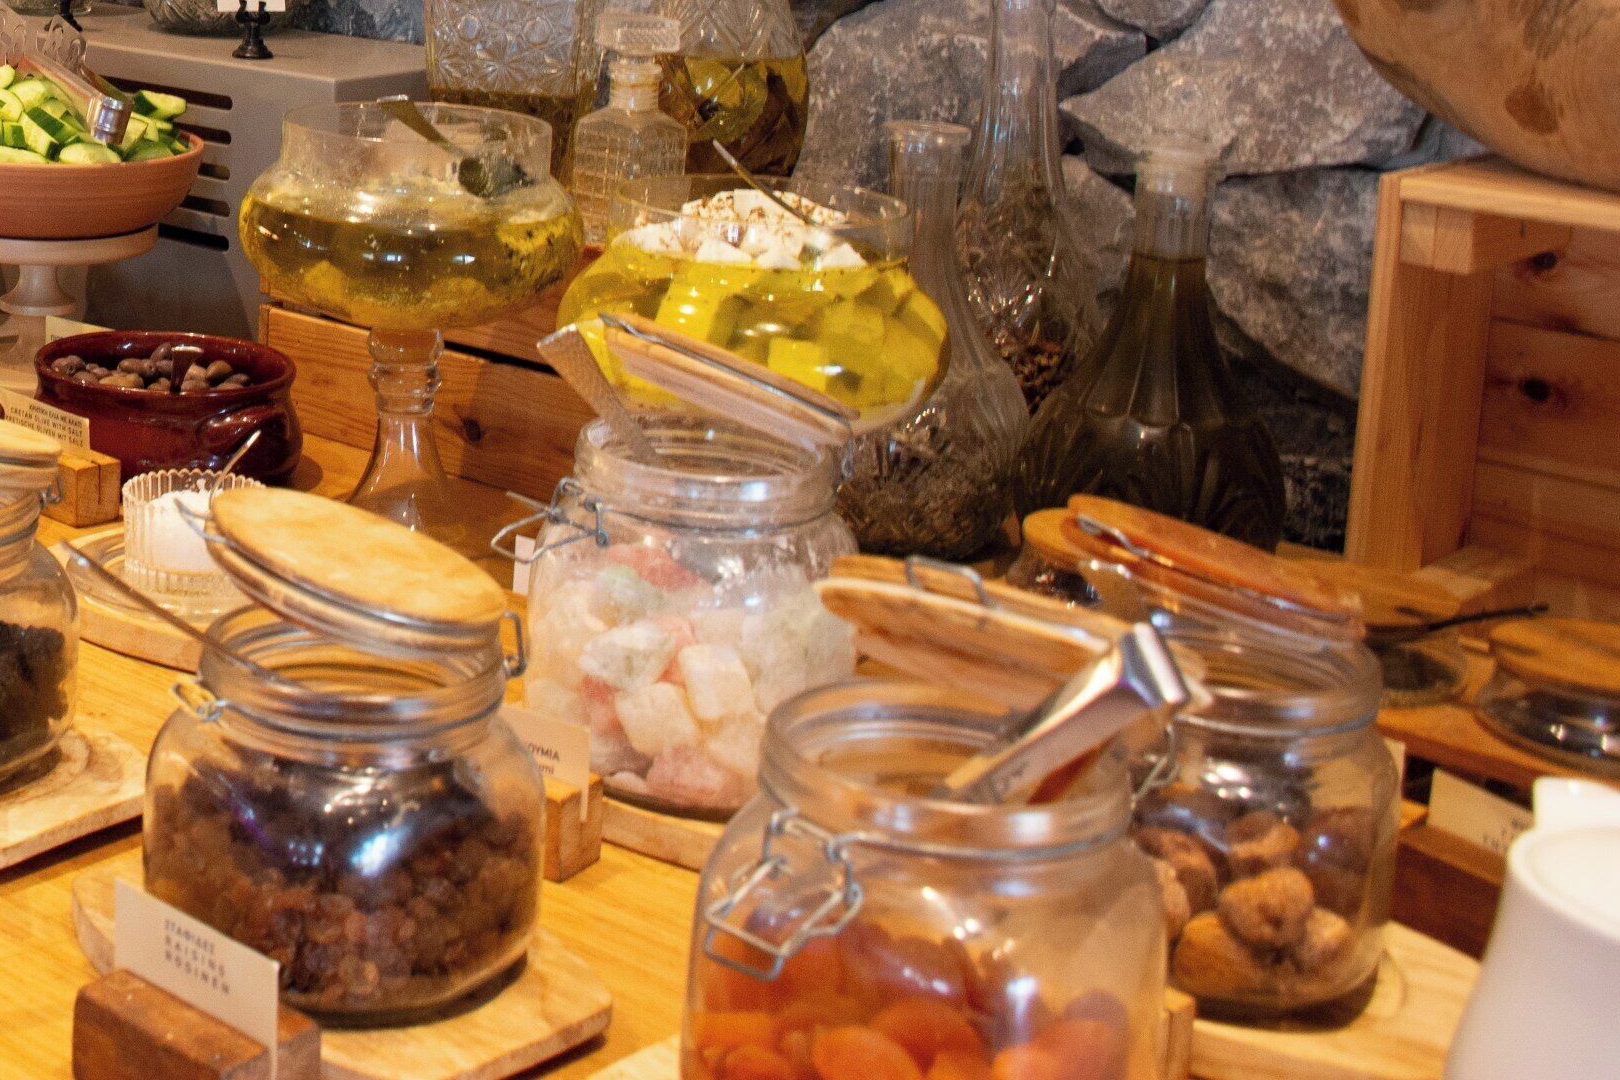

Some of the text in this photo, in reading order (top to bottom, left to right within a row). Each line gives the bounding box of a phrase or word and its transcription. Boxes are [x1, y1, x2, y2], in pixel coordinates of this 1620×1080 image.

[10, 407, 33, 420] CRETAN
[52, 420, 67, 431] WITH
[68, 426, 83, 437] SALT
[68, 436, 84, 447] SALZ
[165, 934, 225, 977] RAISINS
[165, 949, 230, 994] ROSINEN
